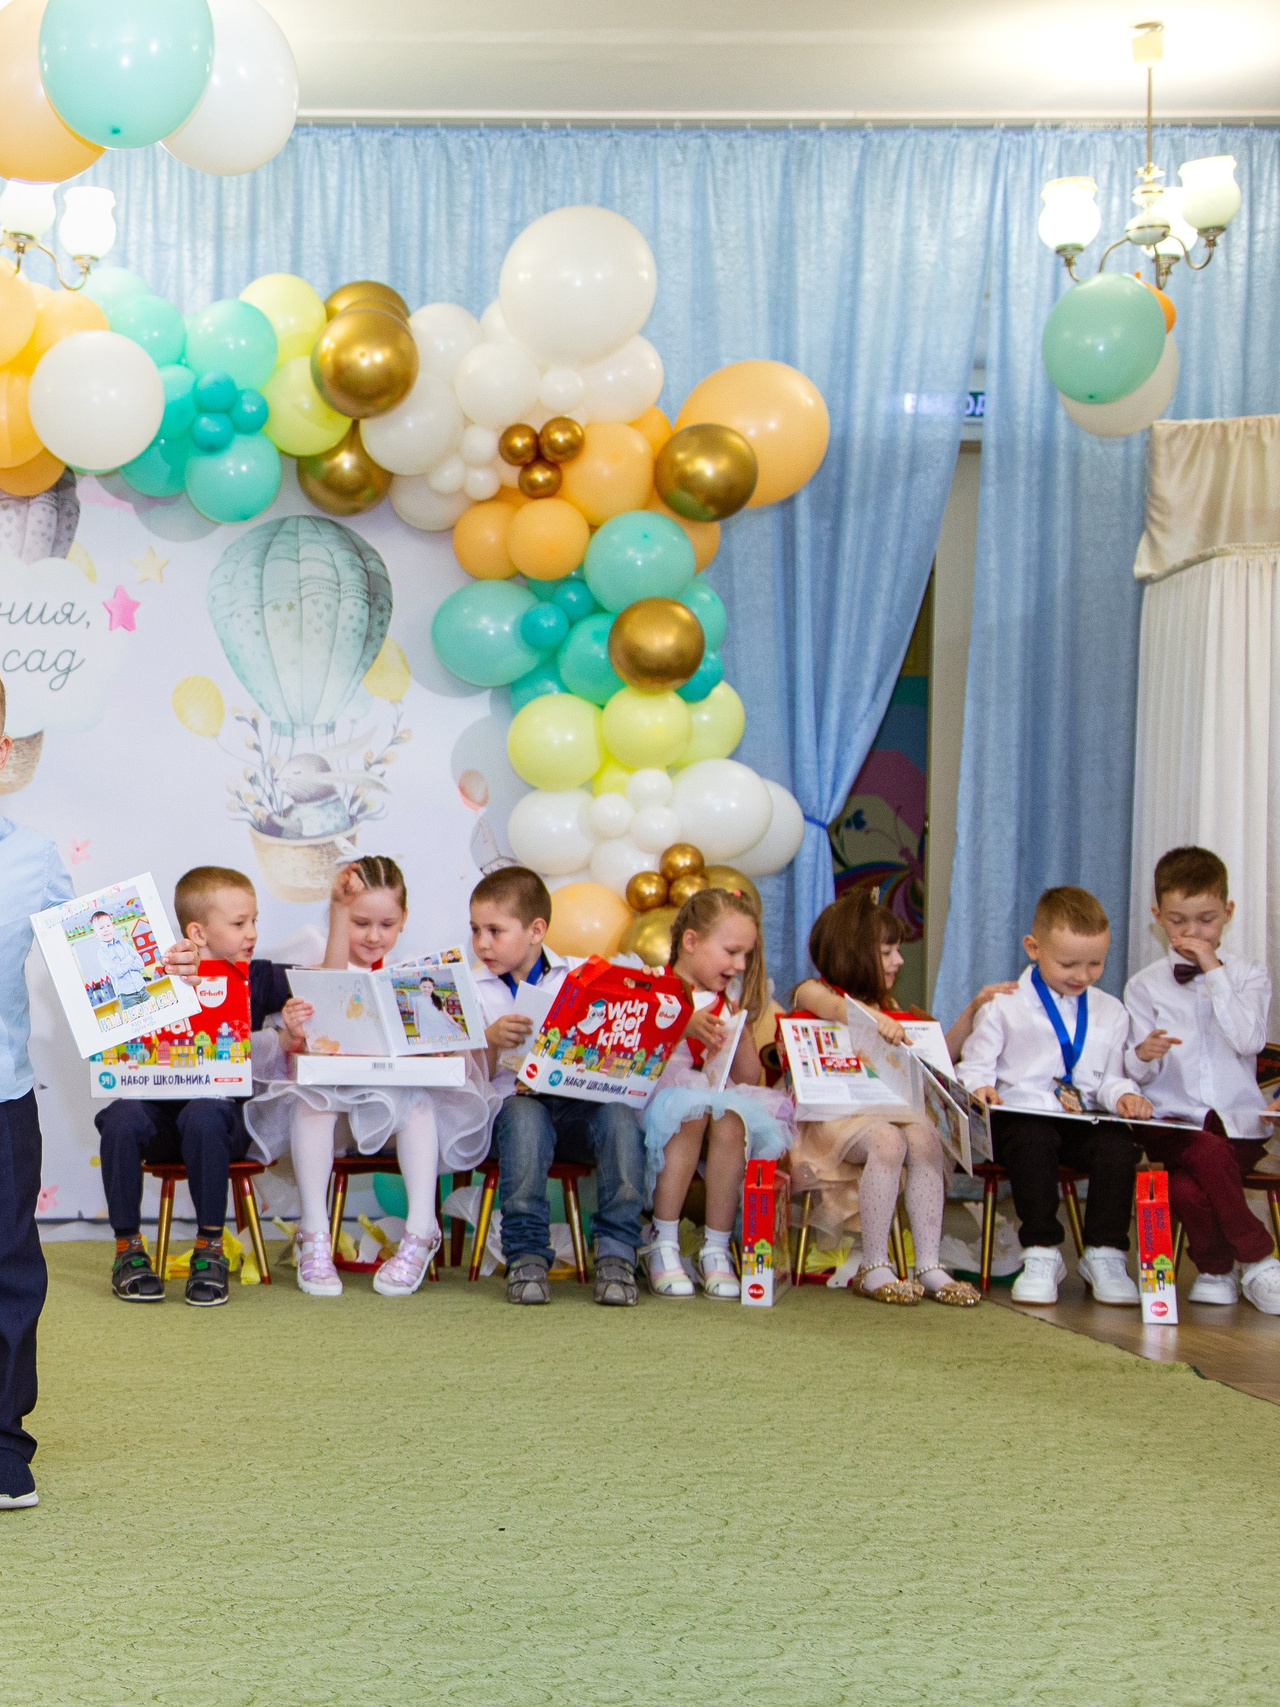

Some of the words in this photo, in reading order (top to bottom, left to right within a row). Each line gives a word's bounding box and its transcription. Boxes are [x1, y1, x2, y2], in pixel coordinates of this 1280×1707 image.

[2, 649, 85, 691] сад
[612, 1014, 648, 1033] der
[597, 1028, 642, 1052] kind!
[121, 1075, 150, 1086] НАБОР
[153, 1074, 211, 1086] ШКОЛЬНИКА
[563, 1075, 587, 1089] НАБОР
[586, 1079, 628, 1096] ШКОЛЬНИКА
